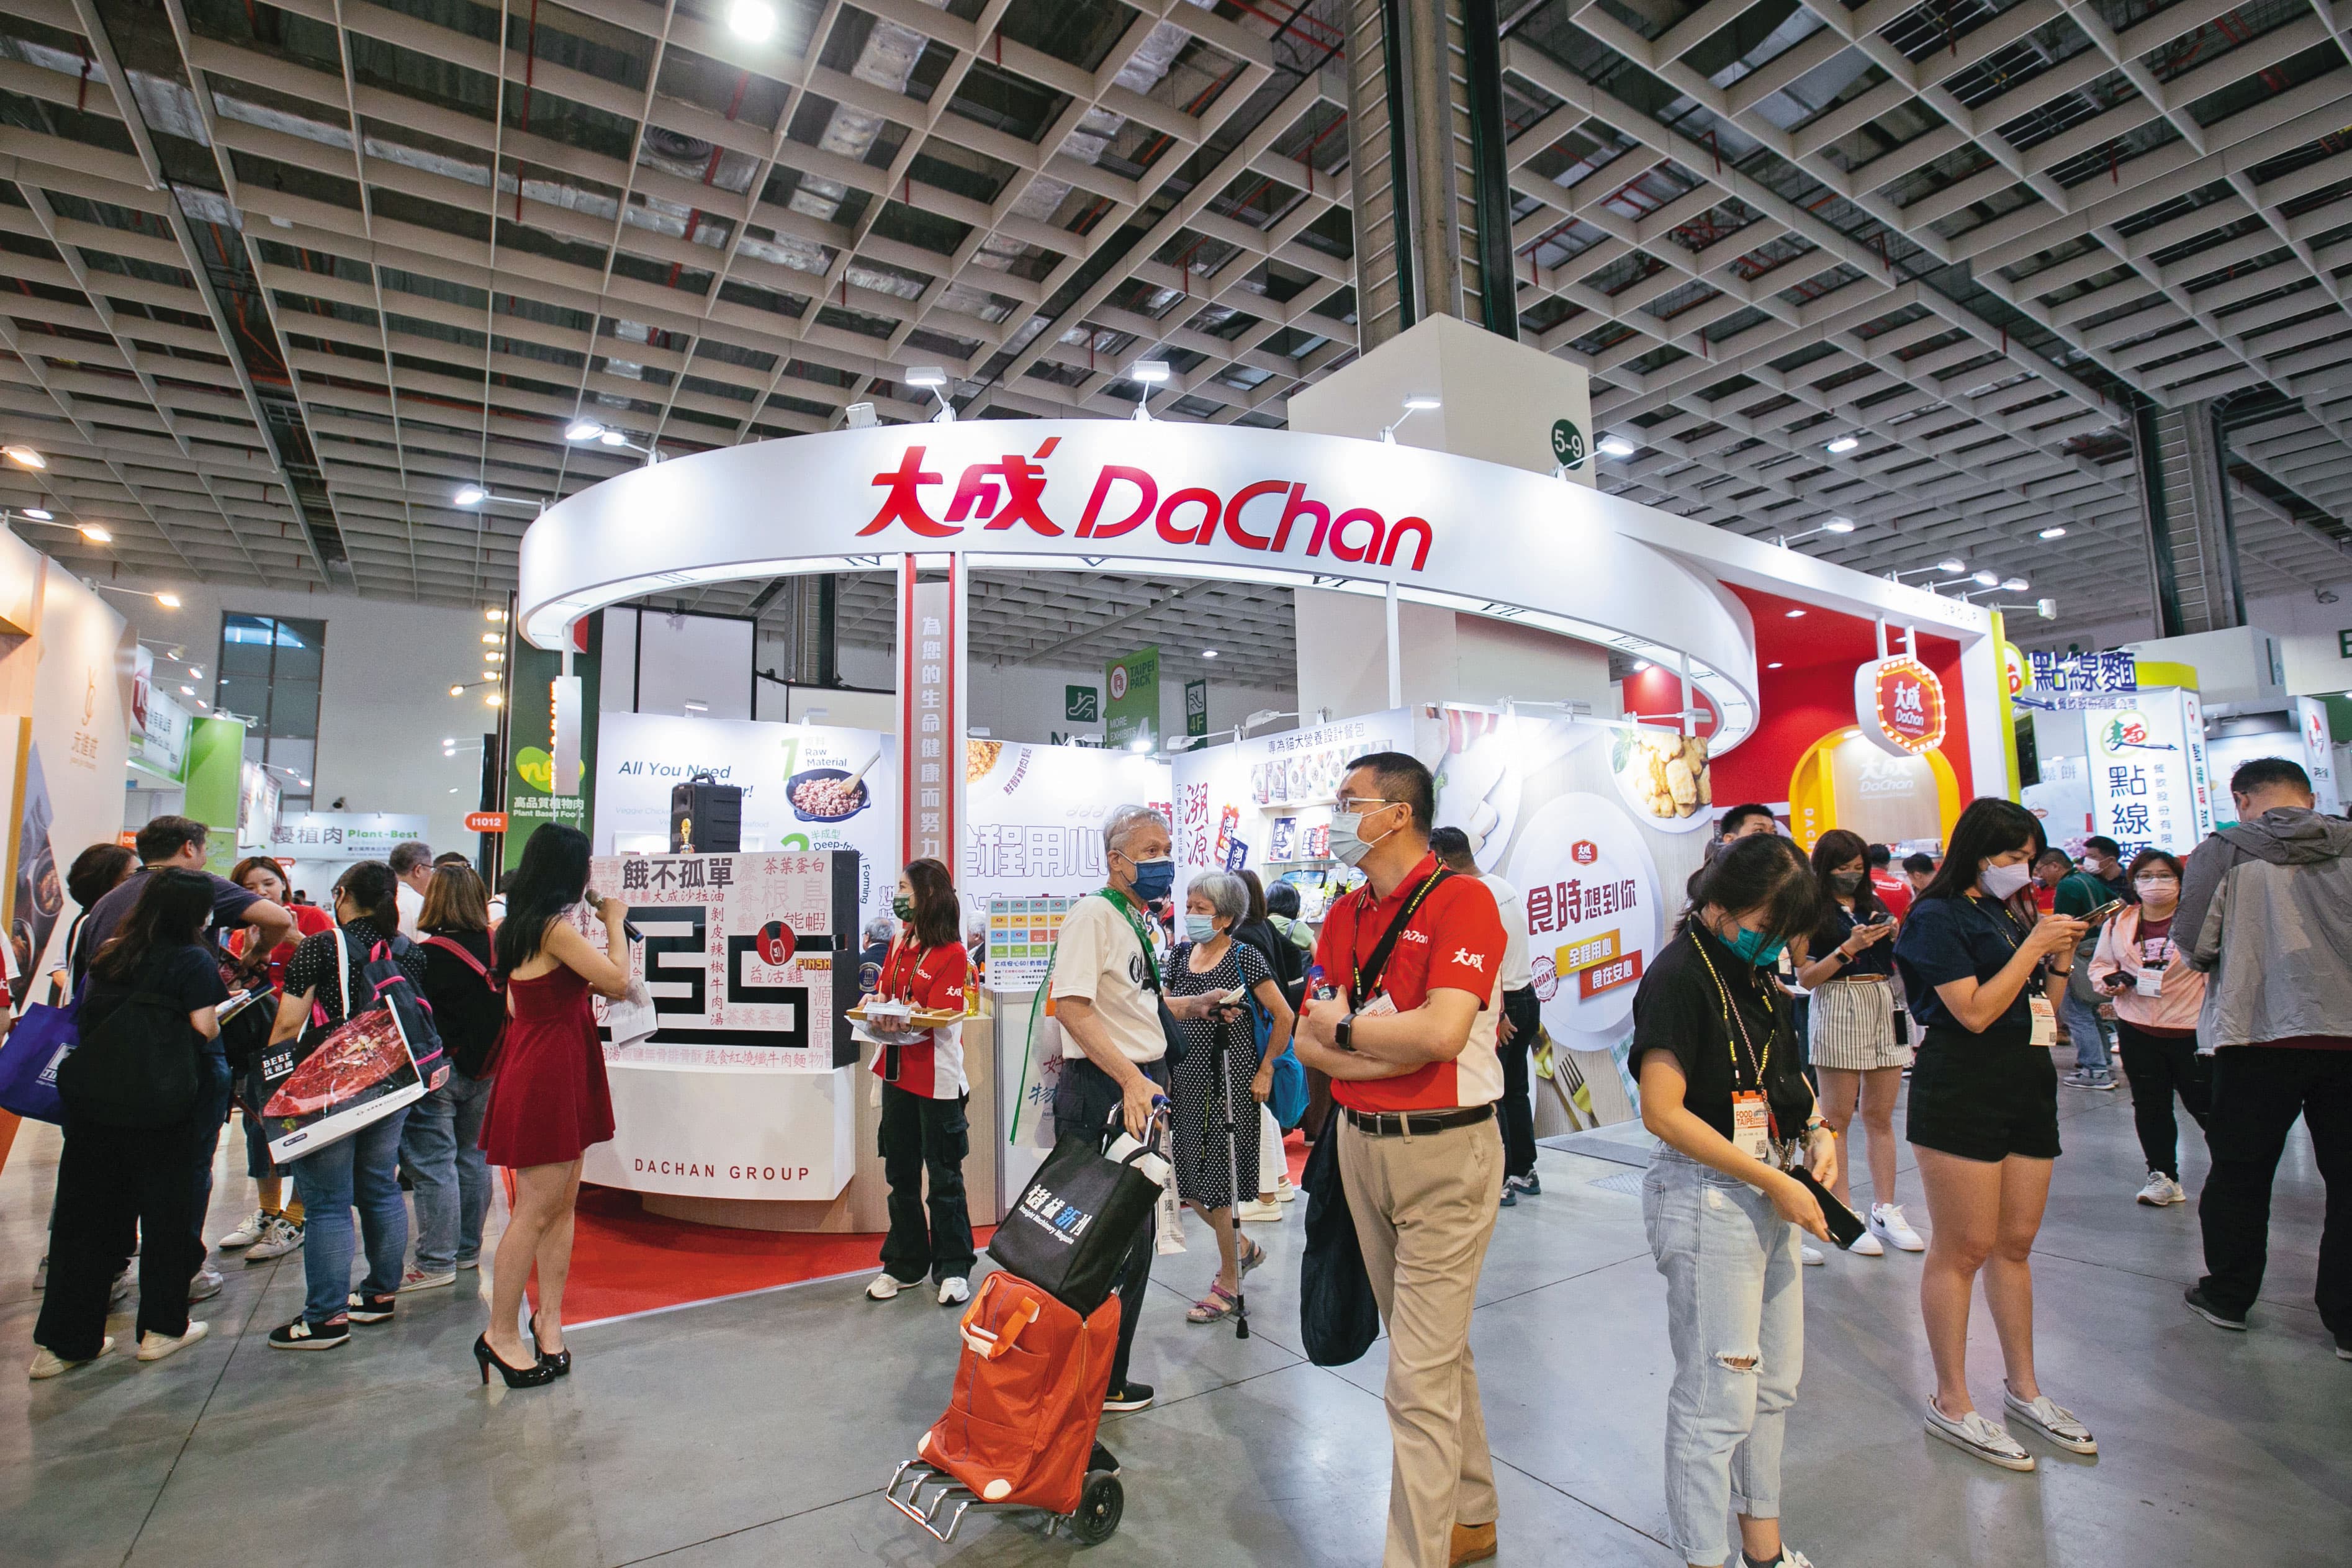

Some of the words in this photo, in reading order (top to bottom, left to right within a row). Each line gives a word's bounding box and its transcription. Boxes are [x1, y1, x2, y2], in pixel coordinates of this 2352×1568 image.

[1554, 428, 1582, 459] 5-9
[855, 436, 1065, 538] 大成
[1074, 464, 1433, 572] DaChan
[1129, 659, 1155, 675] TAIPEI
[2030, 652, 2137, 693] 點線麵
[1129, 674, 1152, 690] PACK
[1893, 680, 1924, 713] 大成
[1110, 716, 1127, 729] MORE
[1189, 714, 1204, 732] 4F
[1895, 709, 1924, 727] DaChan
[920, 616, 941, 858] 為您的生命健康而努力
[1110, 727, 1137, 742] EXHIBITS
[780, 737, 800, 781] 1
[805, 748, 827, 756] Raw
[618, 761, 643, 775] All
[649, 762, 682, 777] You
[687, 764, 731, 779] Need
[807, 758, 847, 767] Material
[514, 796, 585, 810] 高品質植物肉
[472, 818, 502, 827] I1012
[1184, 782, 1209, 867] 溯源
[270, 826, 343, 844] 優植肉
[348, 829, 418, 838] Plant-Best
[811, 829, 840, 840] 半成型
[623, 857, 734, 890] 餓不孤單
[764, 857, 825, 875] 茶葉蛋白
[859, 863, 870, 904] Forming
[652, 888, 725, 903] 大成沙拉油
[1526, 878, 1637, 935] 食時想到你
[1402, 929, 1429, 944] aChan
[1451, 947, 1485, 973] 大成
[1569, 937, 1612, 968] 全程用心
[710, 906, 726, 1026] 剝皮辣椒牛肉湯
[796, 958, 832, 971] FINSH
[1592, 959, 1633, 989] 食在安心
[945, 985, 963, 998] 大成
[262, 1052, 292, 1068] BEEF
[705, 1049, 806, 1068] 蔬食紅燒纖牛肉麵
[1736, 1110, 1753, 1118] FOOD
[1736, 1117, 1755, 1125] TAIPEI
[634, 1158, 714, 1178] DACHAN
[729, 1165, 809, 1181] GROUP
[1019, 1204, 1036, 1219] Insight
[1032, 1214, 1057, 1234] Machinery
[1054, 1228, 1075, 1245] Magazine
